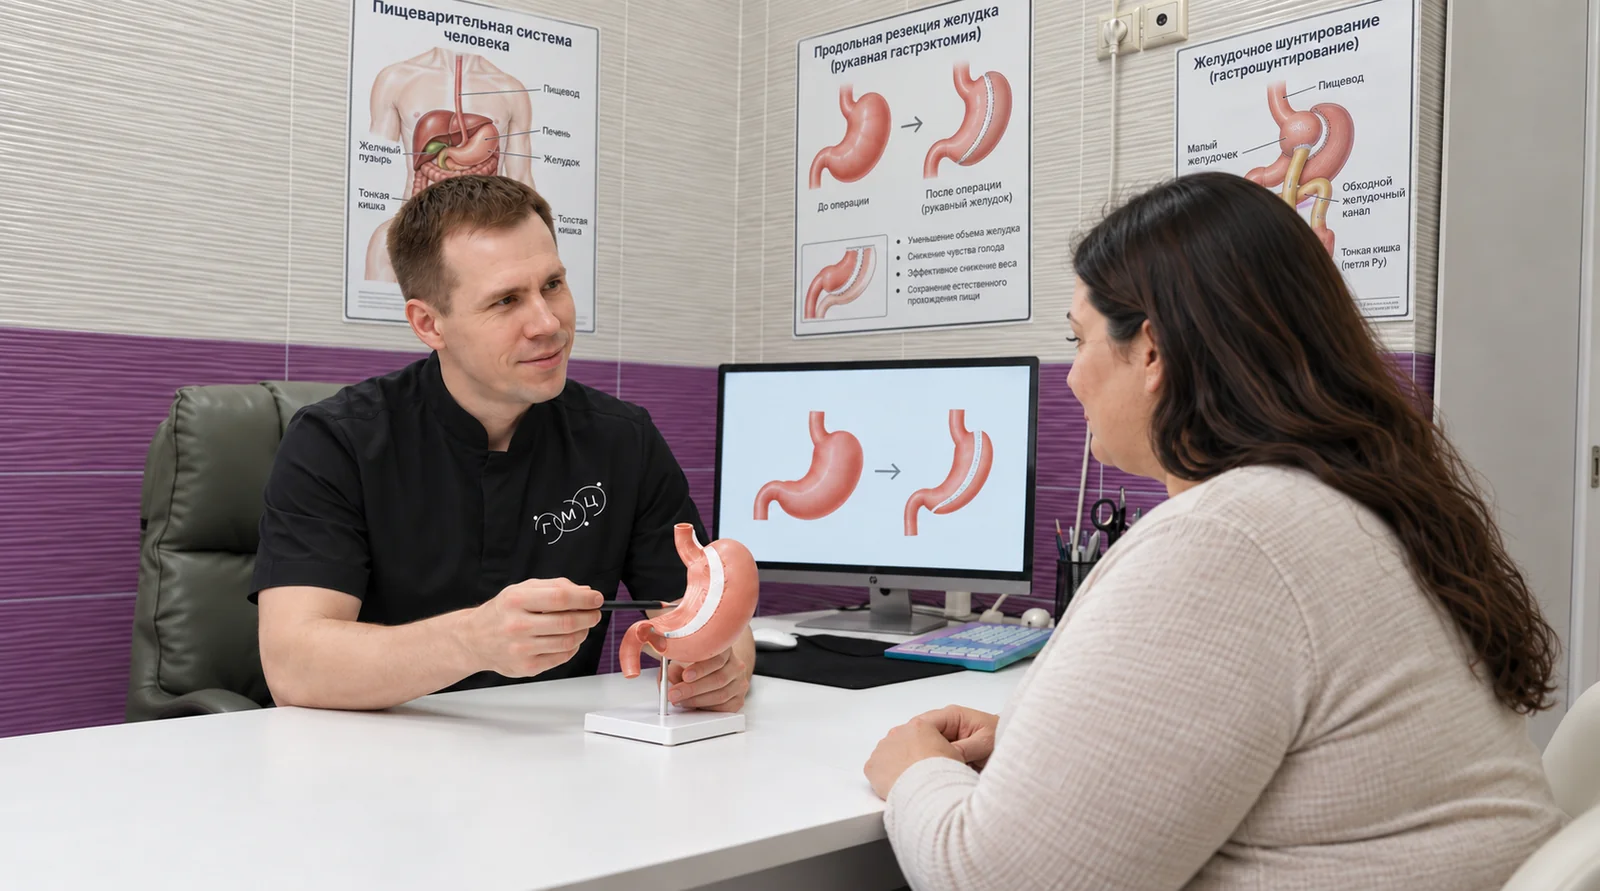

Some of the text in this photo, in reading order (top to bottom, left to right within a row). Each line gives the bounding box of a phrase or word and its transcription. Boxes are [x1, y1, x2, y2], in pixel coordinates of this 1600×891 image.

[373, 0, 572, 47] Пищеварительная система
[814, 6, 999, 59] Продольная резекция желудка
[444, 31, 510, 51] человека
[1193, 14, 1380, 70] Желудочное шунтирование
[831, 26, 982, 74] (рукавная гастрэктомия)
[1209, 36, 1360, 86] (гастрошунтирование)
[1318, 73, 1365, 91] Пищевод
[543, 84, 580, 99] Пищевод
[542, 126, 571, 139] Печень
[359, 140, 401, 155] Желчный
[1187, 139, 1218, 153] Малый
[358, 152, 392, 165] пузырь
[543, 154, 581, 167] Желудок
[1187, 149, 1239, 166] желудочек
[925, 180, 1002, 199] После операции
[1342, 176, 1393, 192] Обходной
[358, 188, 390, 200] Тонкая
[1342, 188, 1406, 206] желудочный
[357, 201, 386, 211] кишка
[817, 197, 870, 213] До операции
[921, 192, 1013, 215] (рукавный желудок)
[558, 215, 588, 226] Толстая
[1342, 207, 1371, 218] канал
[558, 226, 582, 235] кишка
[908, 232, 955, 245] Уменьшение
[985, 224, 1021, 237] желудка
[907, 243, 1005, 261] Снижение чувства голода
[1341, 243, 1401, 257] Тонкая кишка
[907, 260, 1018, 278] Эффективное снижение веса
[1341, 257, 1387, 271] (петля Ру)
[907, 278, 1008, 295] Сохранение естественного
[959, 292, 980, 302] пищи
